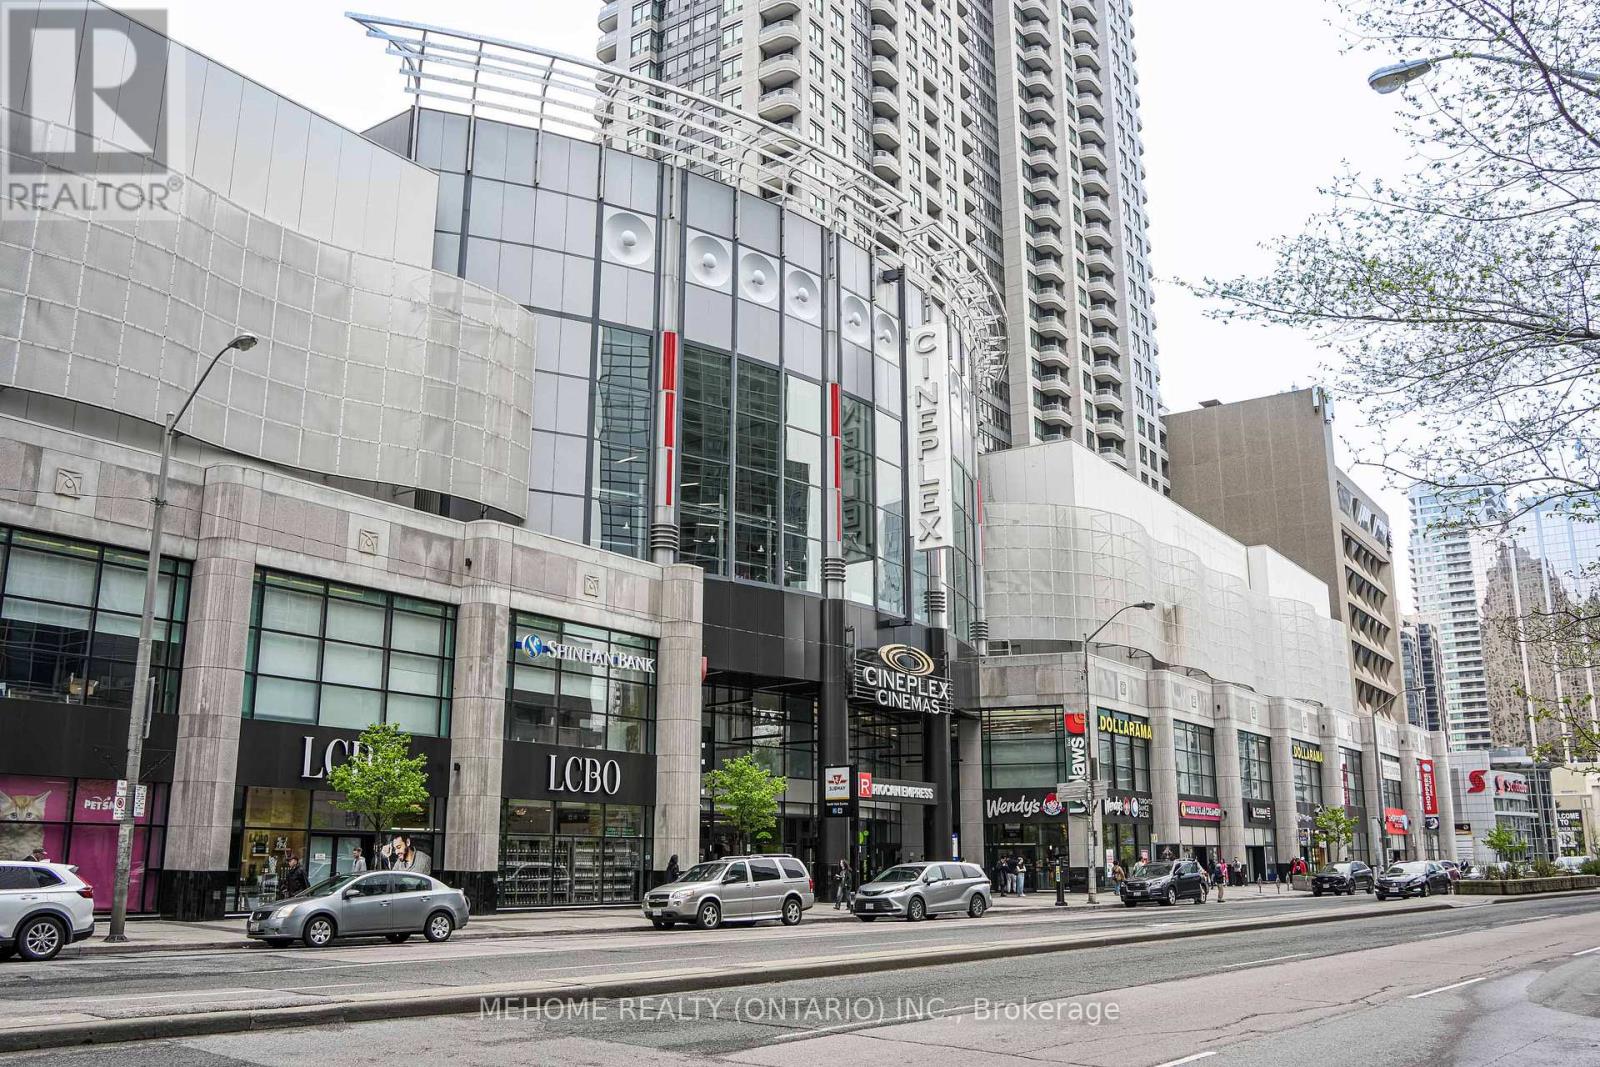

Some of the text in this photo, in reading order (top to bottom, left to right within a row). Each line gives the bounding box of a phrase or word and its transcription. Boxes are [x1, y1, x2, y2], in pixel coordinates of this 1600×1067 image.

[914, 331, 943, 542] CINEPLEX
[547, 640, 656, 673] SHINHAN BANK
[863, 666, 950, 701] CINEPLEX
[875, 689, 940, 715] CINEMAS
[1098, 715, 1153, 740] DOLLARAMA
[548, 754, 621, 795] LCBO
[902, 786, 934, 800] EMPRESS
[986, 794, 1040, 818] Wendy's
[1104, 796, 1123, 815] Wendy's
